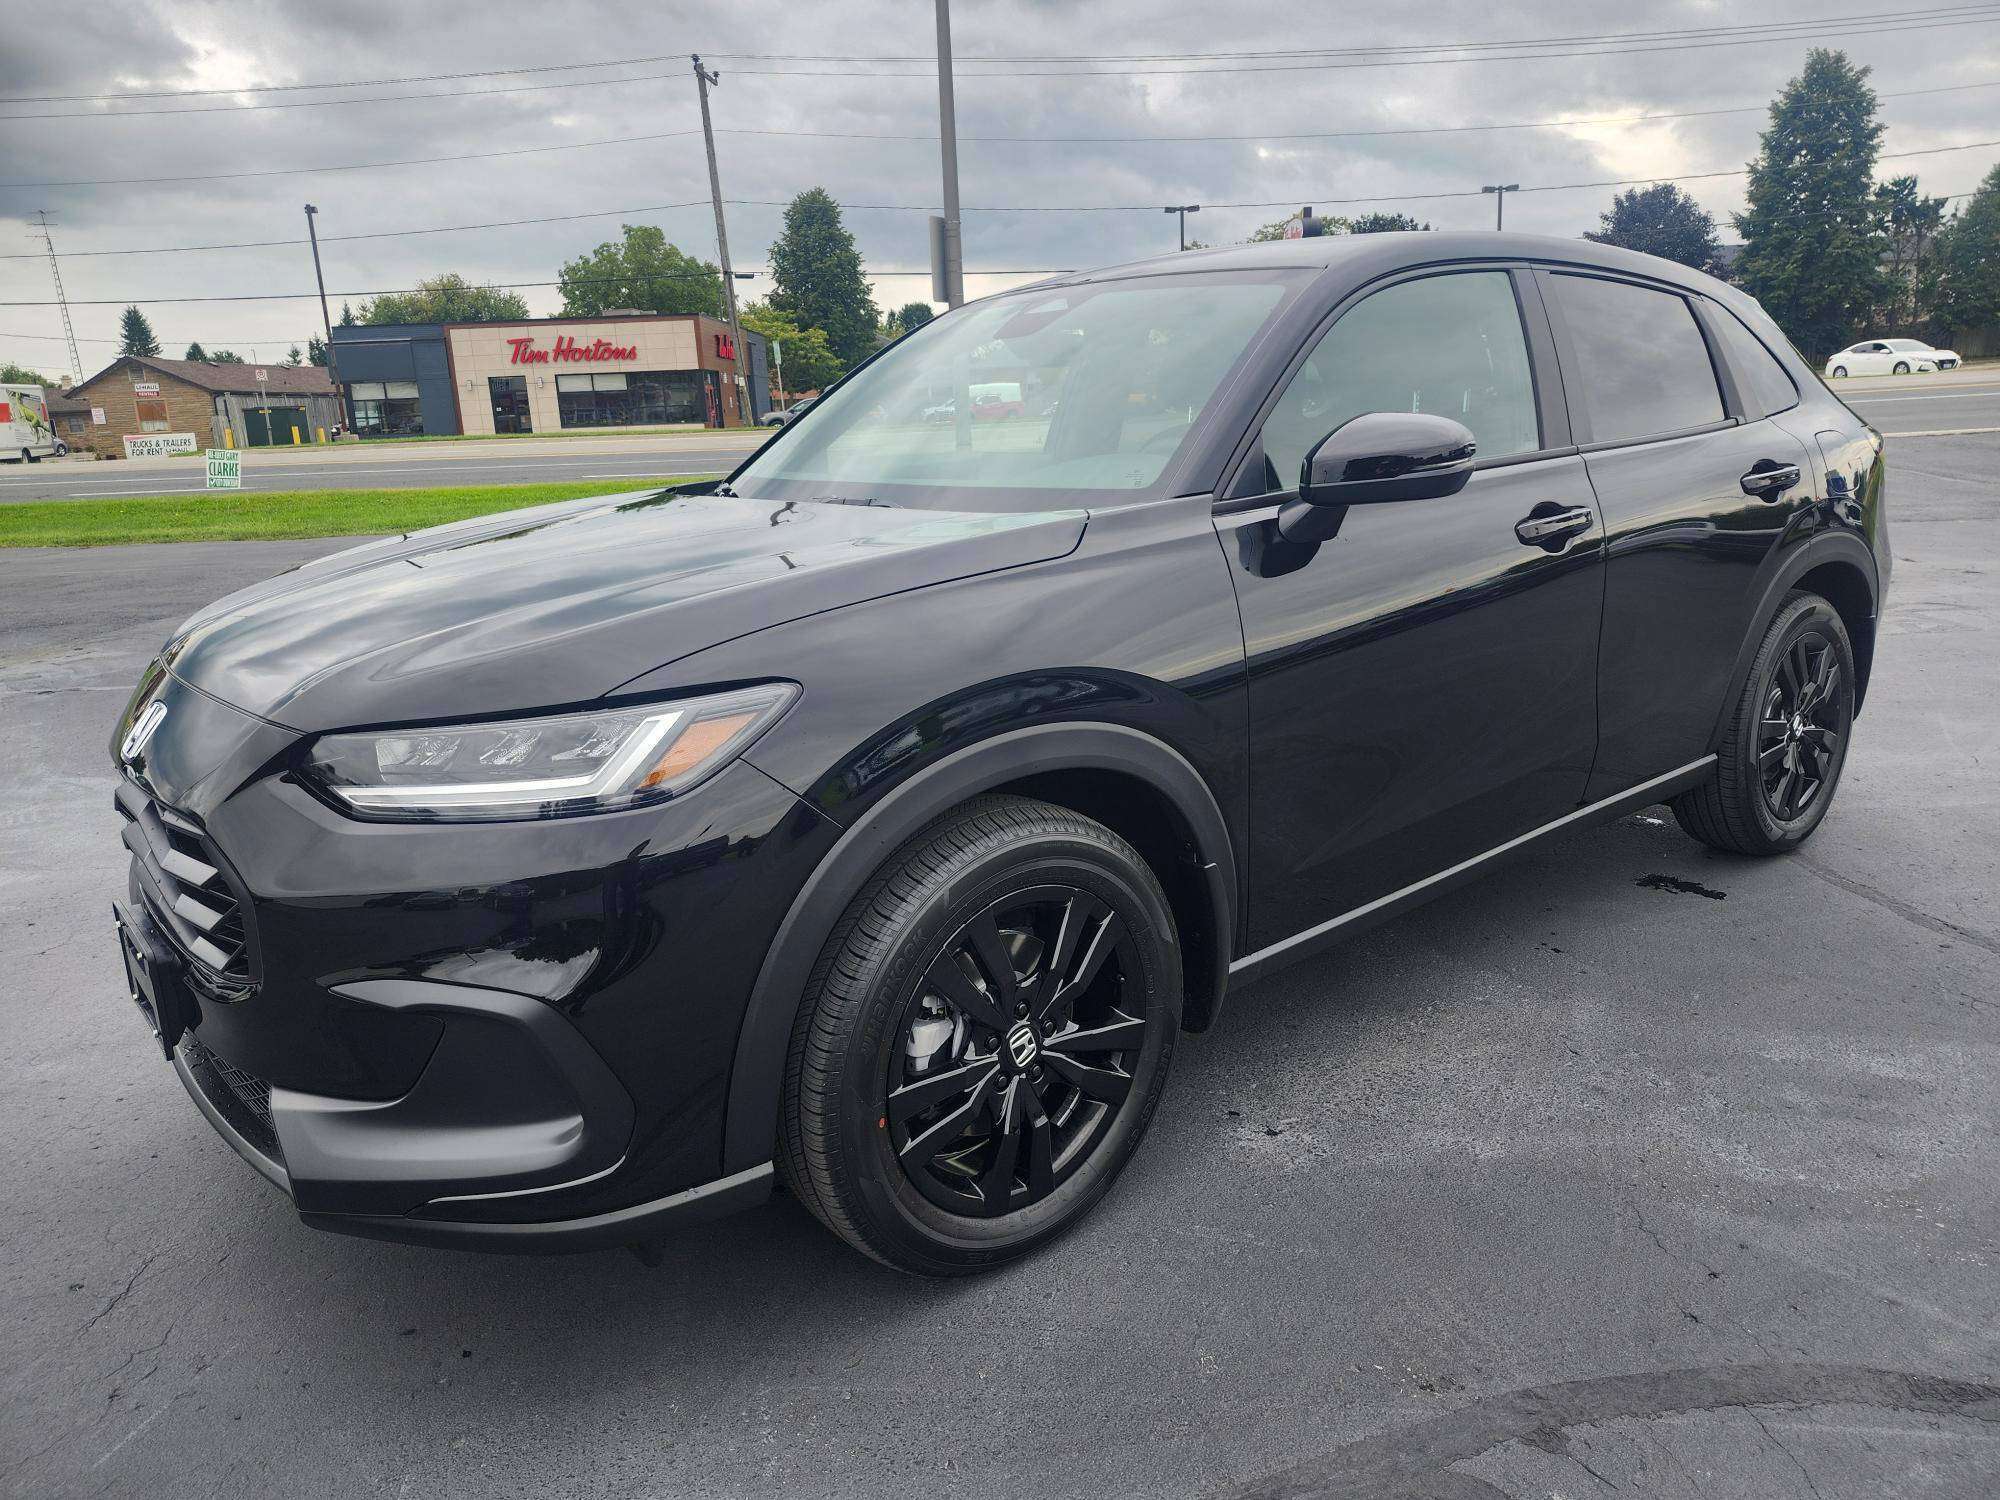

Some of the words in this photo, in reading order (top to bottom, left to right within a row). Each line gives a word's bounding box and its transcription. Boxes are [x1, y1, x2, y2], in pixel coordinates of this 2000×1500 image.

[507, 337, 549, 364] Tim
[552, 335, 638, 363] Hortons
[130, 440, 153, 449] TRUCKS
[155, 440, 161, 448] &
[163, 438, 192, 448] TRAILERS
[131, 448, 145, 457] FOR
[146, 447, 163, 456] RENT
[208, 461, 239, 477] CLARKE
